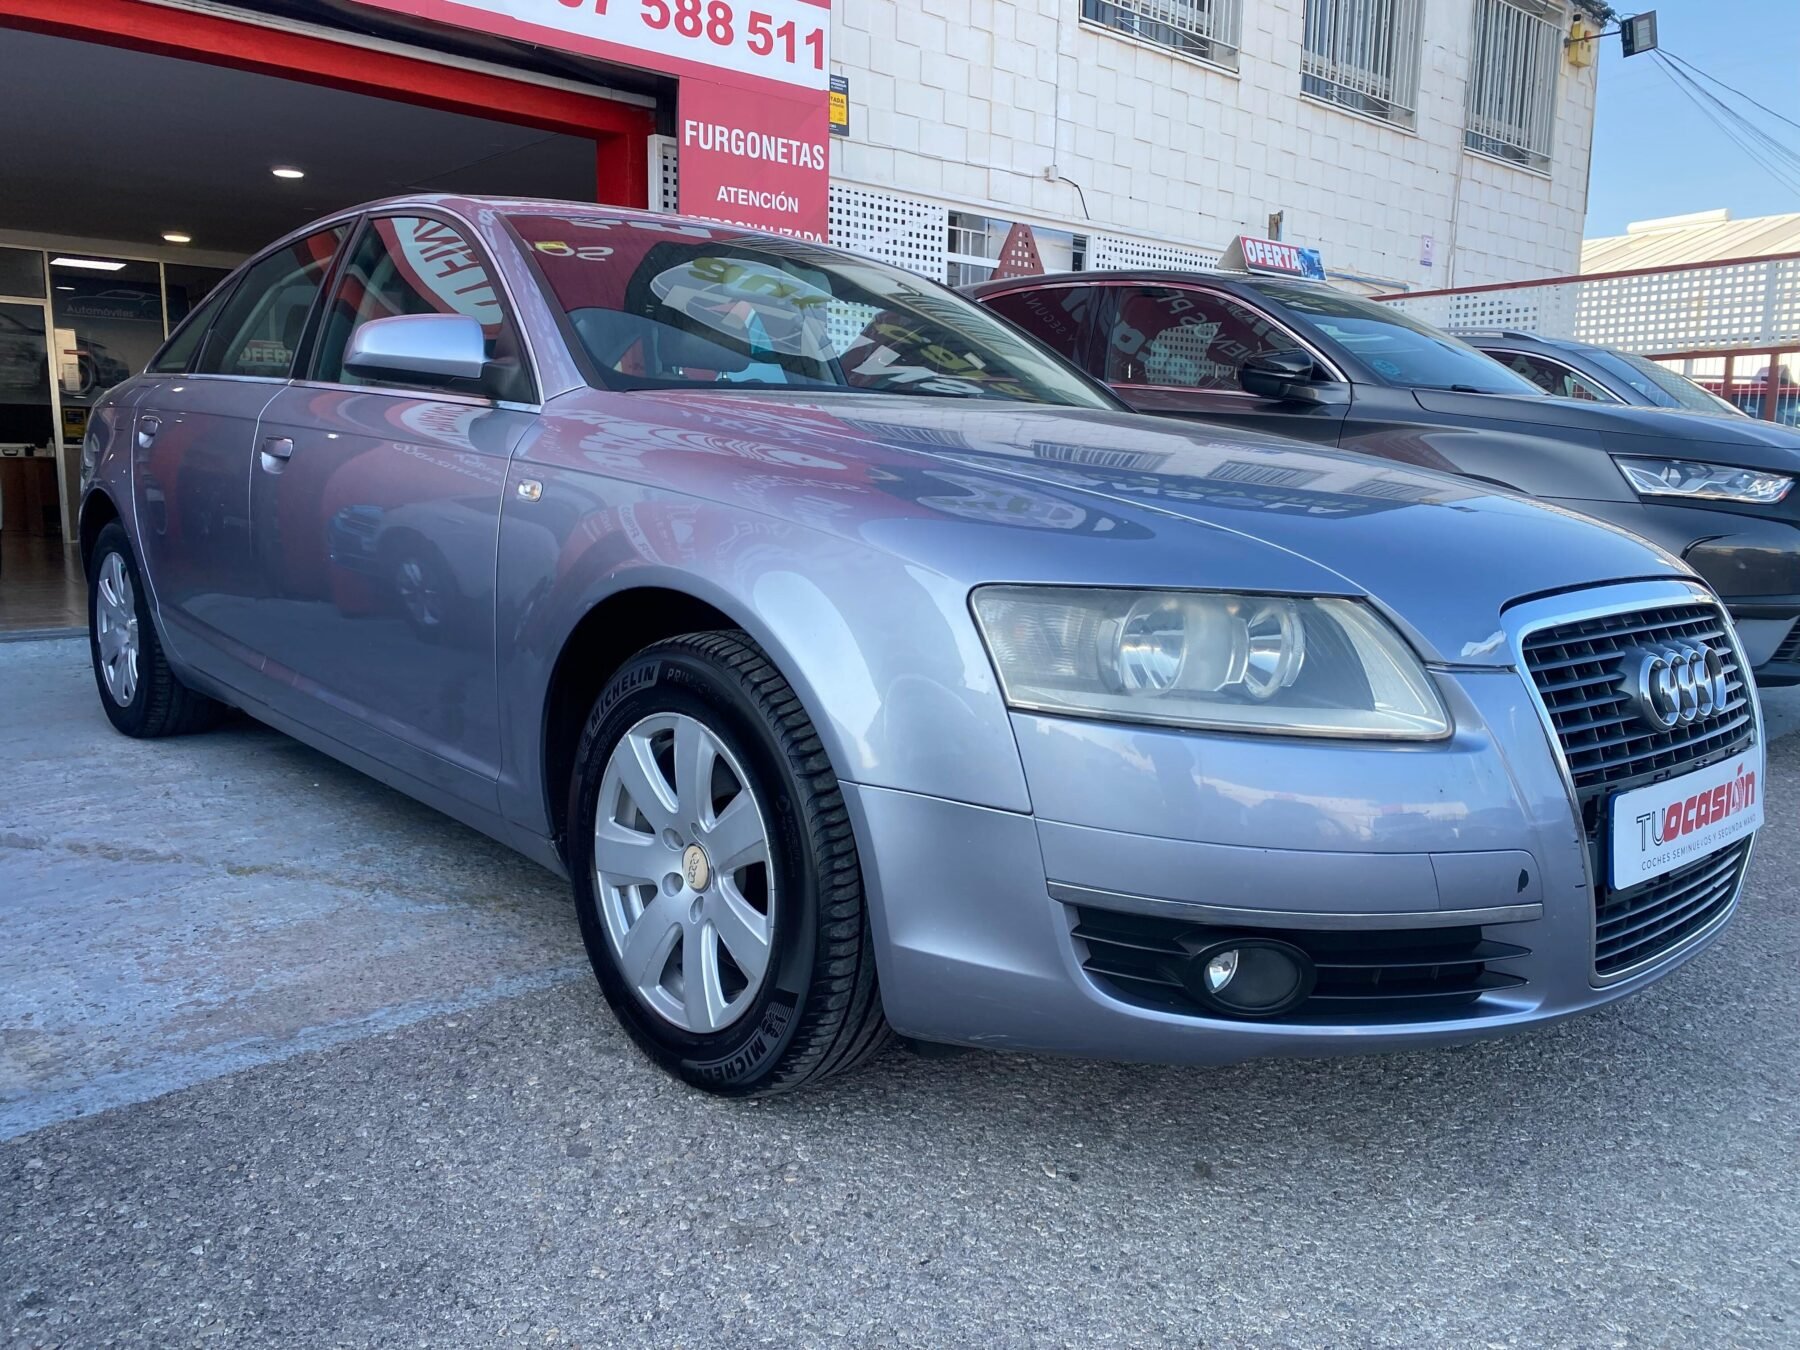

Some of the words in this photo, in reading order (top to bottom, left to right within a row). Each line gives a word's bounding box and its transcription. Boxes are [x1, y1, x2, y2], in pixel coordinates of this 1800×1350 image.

[747, 10, 824, 70] 511
[685, 119, 825, 171] FURGONETAS
[716, 185, 799, 214] ATENCIÓN
[1246, 239, 1300, 271] OFERTA
[66, 304, 135, 318] Automóviles
[240, 347, 293, 364] OFERT
[590, 664, 657, 729] MICHELIN
[1641, 852, 1671, 871] COCHES
[1672, 836, 1712, 860] SEMINUEVOS
[1718, 821, 1743, 840] SEGUNDA
[686, 1034, 768, 1081] MICHEL
